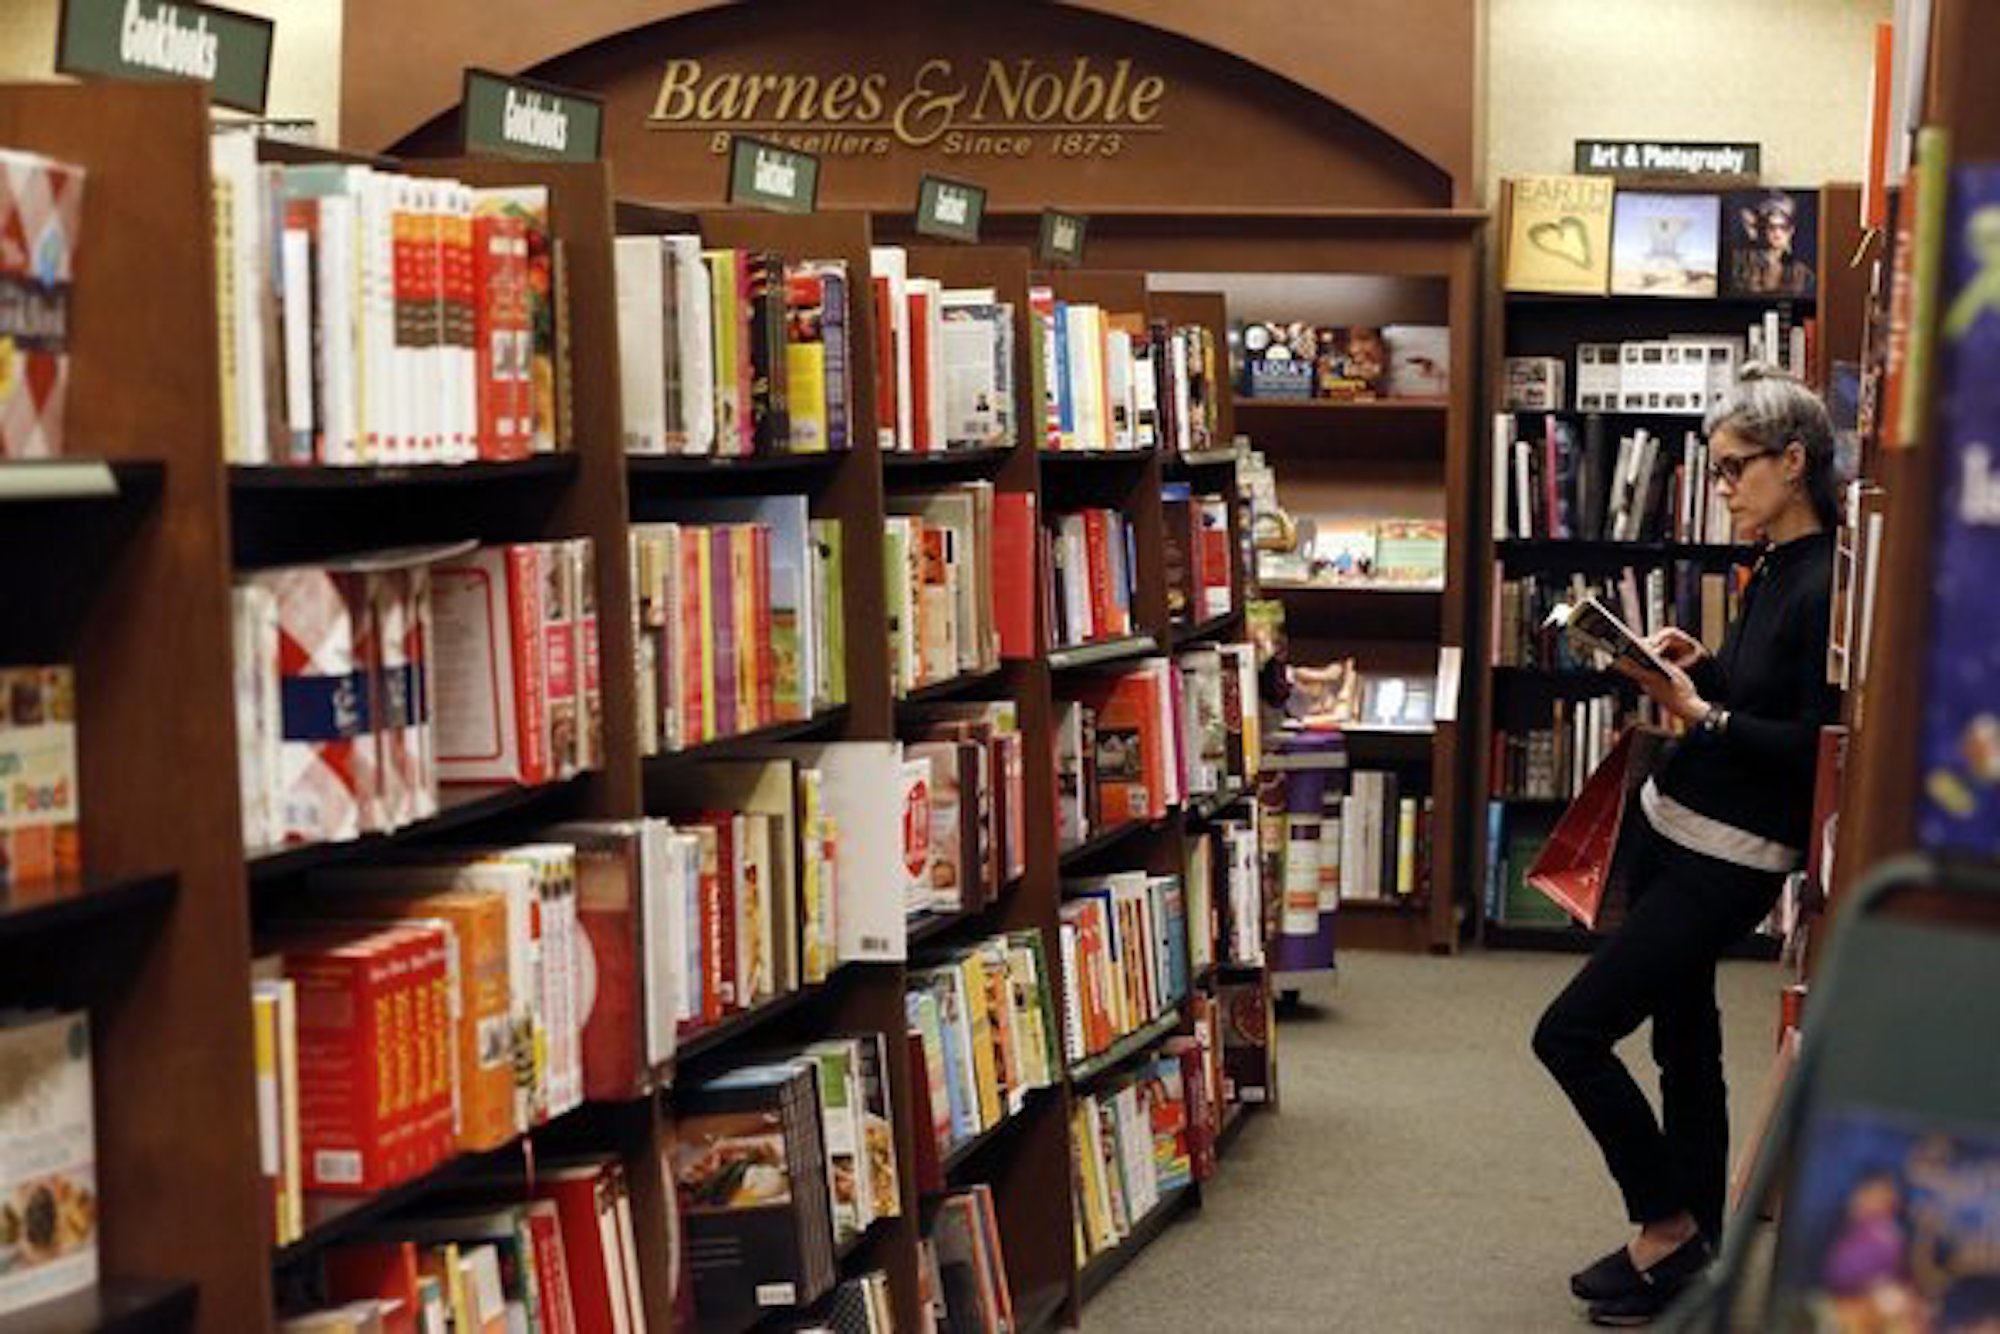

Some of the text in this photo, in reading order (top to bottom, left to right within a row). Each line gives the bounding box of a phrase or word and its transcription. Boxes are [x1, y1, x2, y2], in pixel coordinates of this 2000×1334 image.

[648, 56, 1164, 145] Barnes & Noble
[944, 132, 1032, 155] Since
[1052, 132, 1122, 155] 1873
[1590, 143, 1745, 174] Art & Photography
